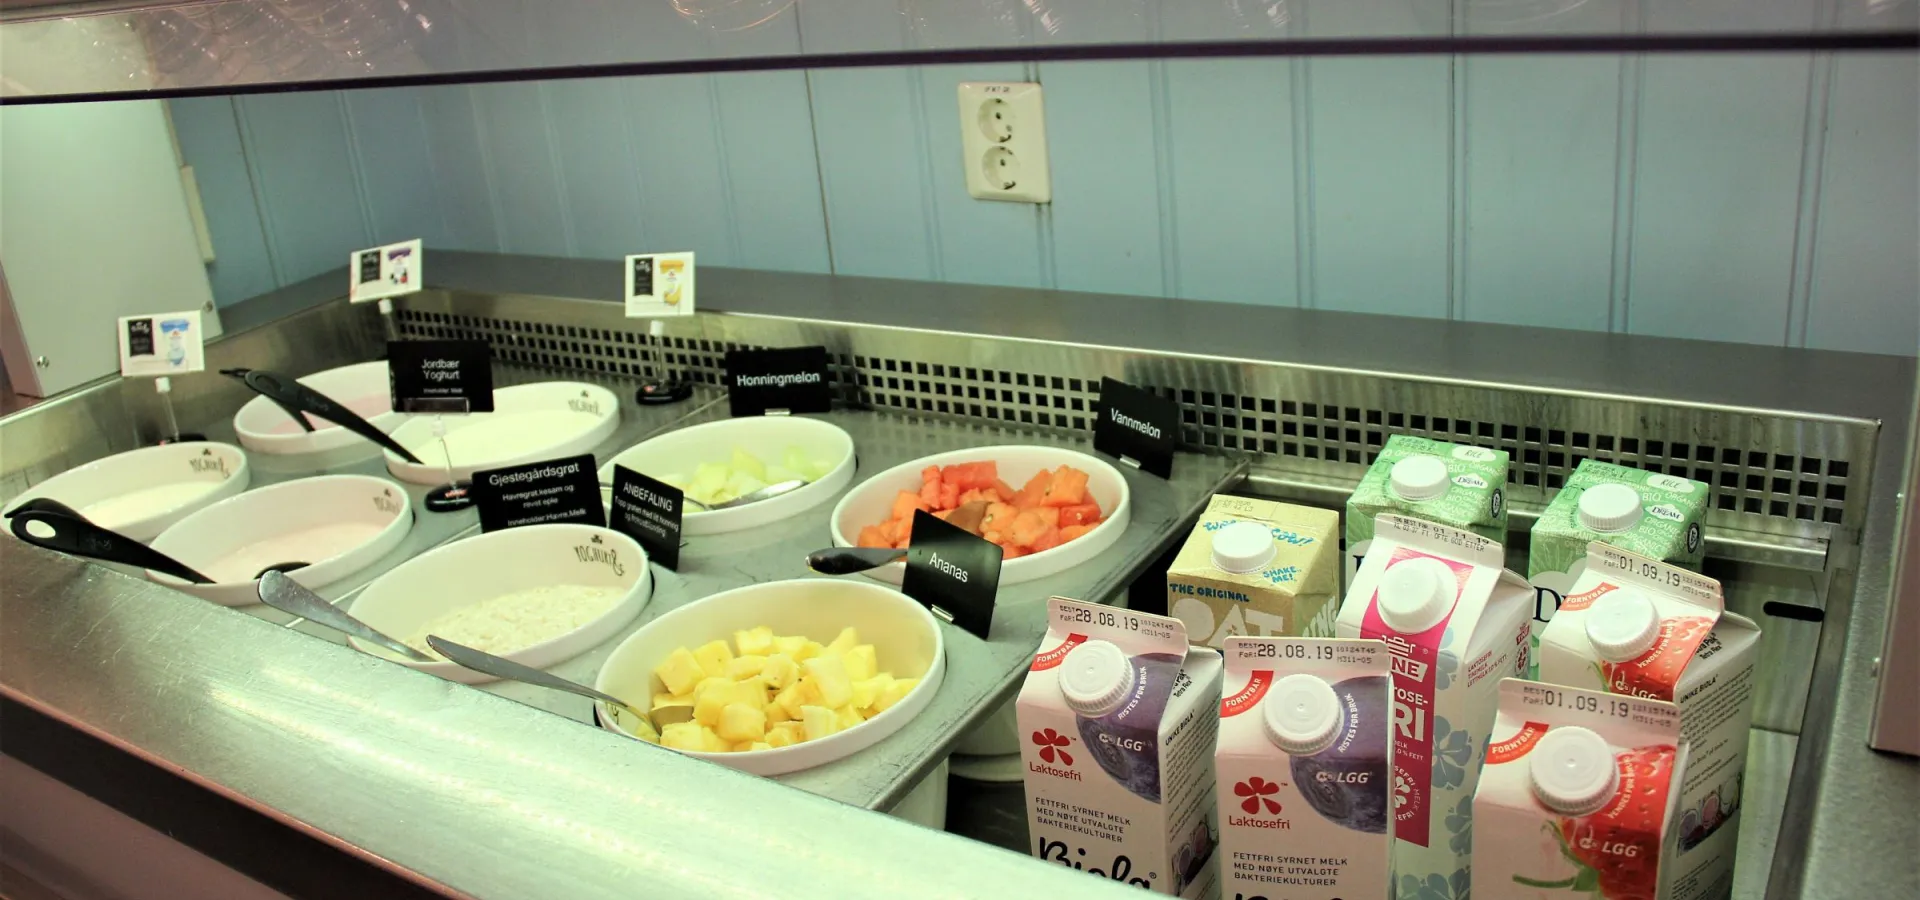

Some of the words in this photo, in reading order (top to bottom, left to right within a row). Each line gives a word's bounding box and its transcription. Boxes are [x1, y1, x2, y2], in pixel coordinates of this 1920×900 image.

[422, 359, 460, 369] Jordbær
[423, 370, 460, 382] Yoghurt
[736, 371, 820, 387] Honningmelon
[1110, 407, 1160, 439] Vannmelon
[1464, 450, 1482, 458] RICE
[489, 462, 580, 487] Gjestegårdsgrøt
[1457, 476, 1484, 487] DREAM
[564, 484, 574, 493] og
[1660, 479, 1680, 489] RICE
[623, 481, 672, 512] ANBEFALING
[1642, 493, 1662, 502] BIO
[1651, 505, 1682, 520] DREAM
[1638, 525, 1657, 536] BIO
[1604, 551, 1620, 561] BEST
[928, 552, 968, 583] Ananas
[1263, 566, 1297, 578] SHAKE
[1619, 556, 1681, 587] 01.09.19
[1272, 573, 1293, 583] ME!
[1169, 583, 1195, 595] THE
[1196, 587, 1251, 603] ORIGINAL
[1566, 587, 1608, 604] FORNYBAR
[1060, 605, 1075, 613] BEST
[1075, 608, 1138, 631] 28.08.19
[1036, 640, 1075, 663] FORNYBAR
[1257, 644, 1333, 660] 28.08.19
[1139, 666, 1148, 686] BRUK
[1134, 685, 1146, 701] FØR
[1225, 678, 1262, 709] FORNYBAR
[1523, 686, 1545, 695] BEST
[1118, 699, 1138, 721] RISTES
[1344, 693, 1359, 714] BRUK
[1545, 690, 1629, 718] 01.09.19
[1349, 713, 1359, 729] FØR
[1394, 700, 1425, 741] RI
[1116, 736, 1143, 752] LGG
[1337, 728, 1357, 753] RISTES
[1492, 726, 1535, 754] FORNYBAR
[1409, 752, 1424, 761] FETT
[1029, 761, 1082, 782] Laktosefri
[1337, 772, 1369, 783] LGG
[1394, 765, 1416, 786] SEFRI
[1035, 797, 1070, 811] FETTFRI
[1072, 805, 1105, 819] SYRNET
[1107, 814, 1131, 826] MELK
[1036, 807, 1054, 817] MED
[1057, 811, 1079, 823] NØYE
[1081, 818, 1124, 834] UTVALGTE
[1229, 815, 1290, 830] Laktosefri
[1037, 816, 1123, 844] BAKTERIEKULTURER
[1602, 842, 1638, 858] LGG
[1233, 852, 1274, 863] FETTFRI
[1277, 856, 1316, 865] SYRNET
[1319, 858, 1348, 866] MELK
[1234, 862, 1255, 871] MED
[1258, 866, 1285, 874] NØYE
[1287, 868, 1339, 876] UTVALGTE
[1234, 872, 1337, 886] BAKTERIEKULTURER
